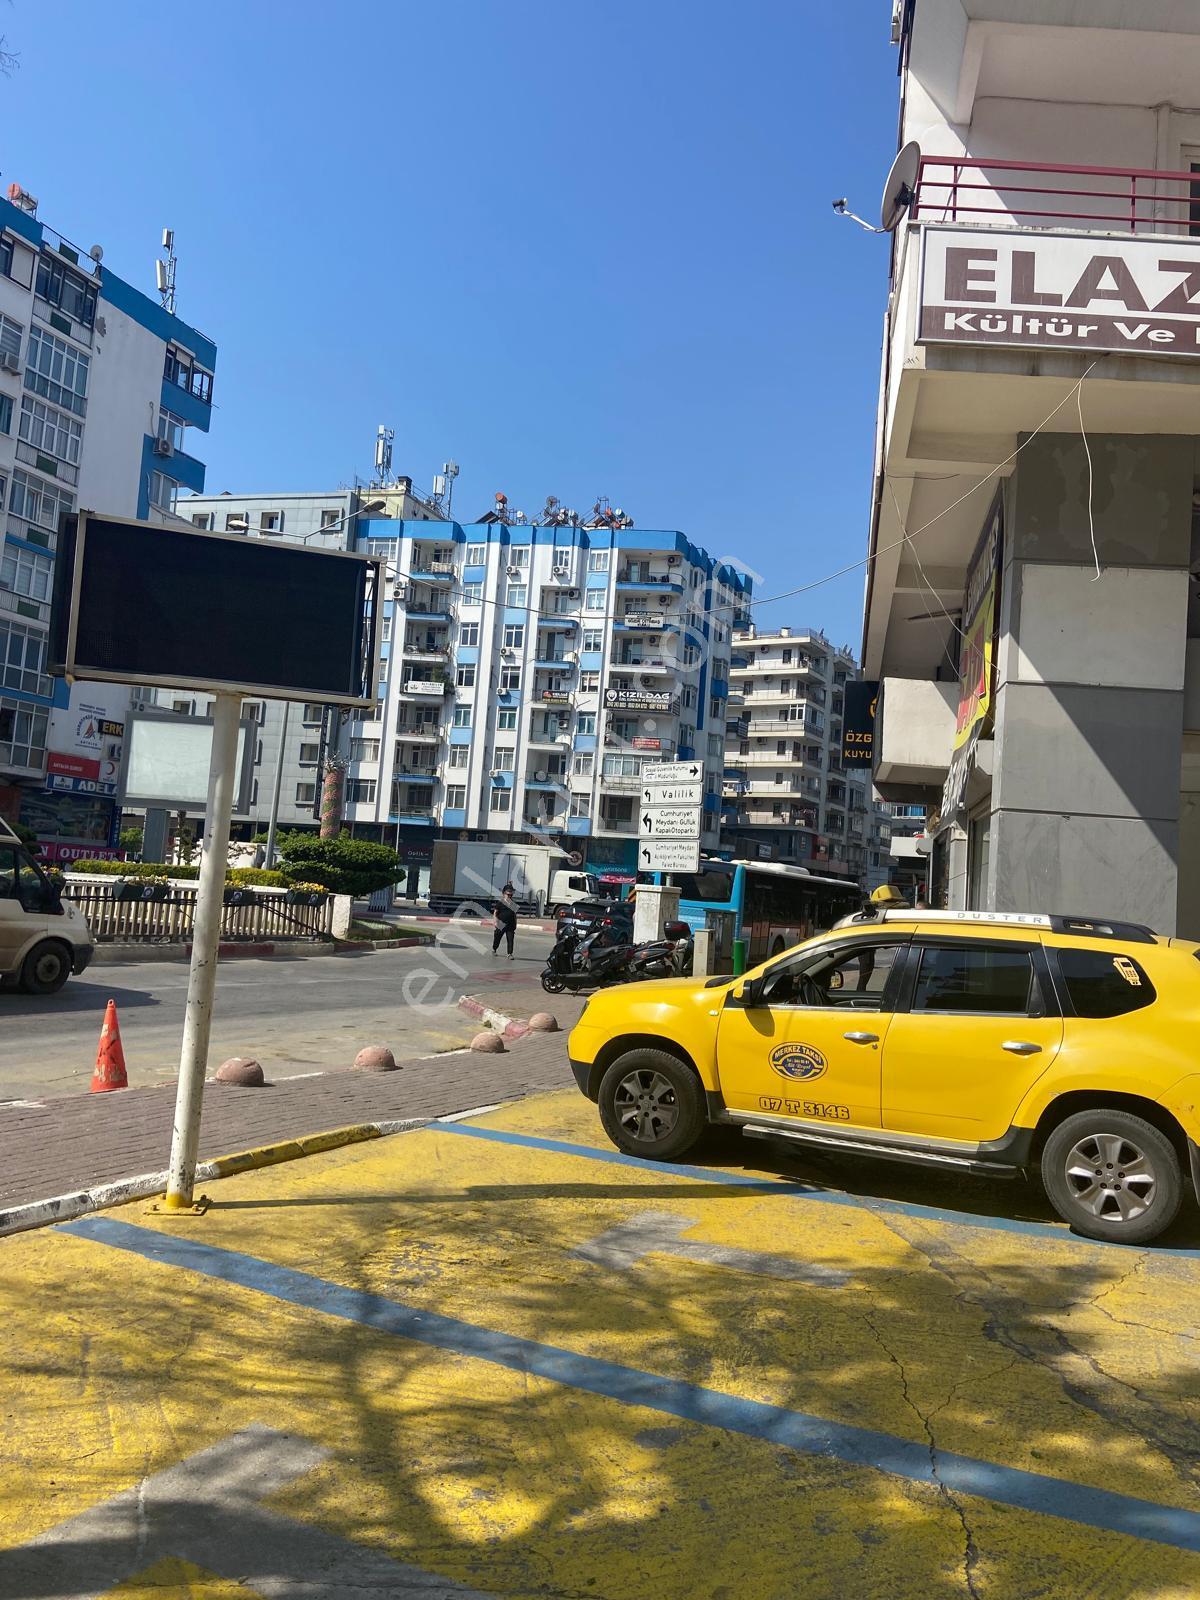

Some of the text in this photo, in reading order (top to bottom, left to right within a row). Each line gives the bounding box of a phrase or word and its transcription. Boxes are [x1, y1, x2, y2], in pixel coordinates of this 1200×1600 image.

[944, 247, 1200, 314] ELAZ
[944, 312, 1176, 343] Kültür Ve
[846, 729, 872, 743] ÖZG
[844, 750, 872, 759] KUYU
[662, 789, 694, 799] Valilik
[660, 810, 693, 818] Cumhuriyet
[60, 848, 117, 861] OUTLET
[957, 912, 1043, 924] DUSTER
[774, 1045, 801, 1059] MERKEZ
[759, 1097, 850, 1120] 07 T 3146
